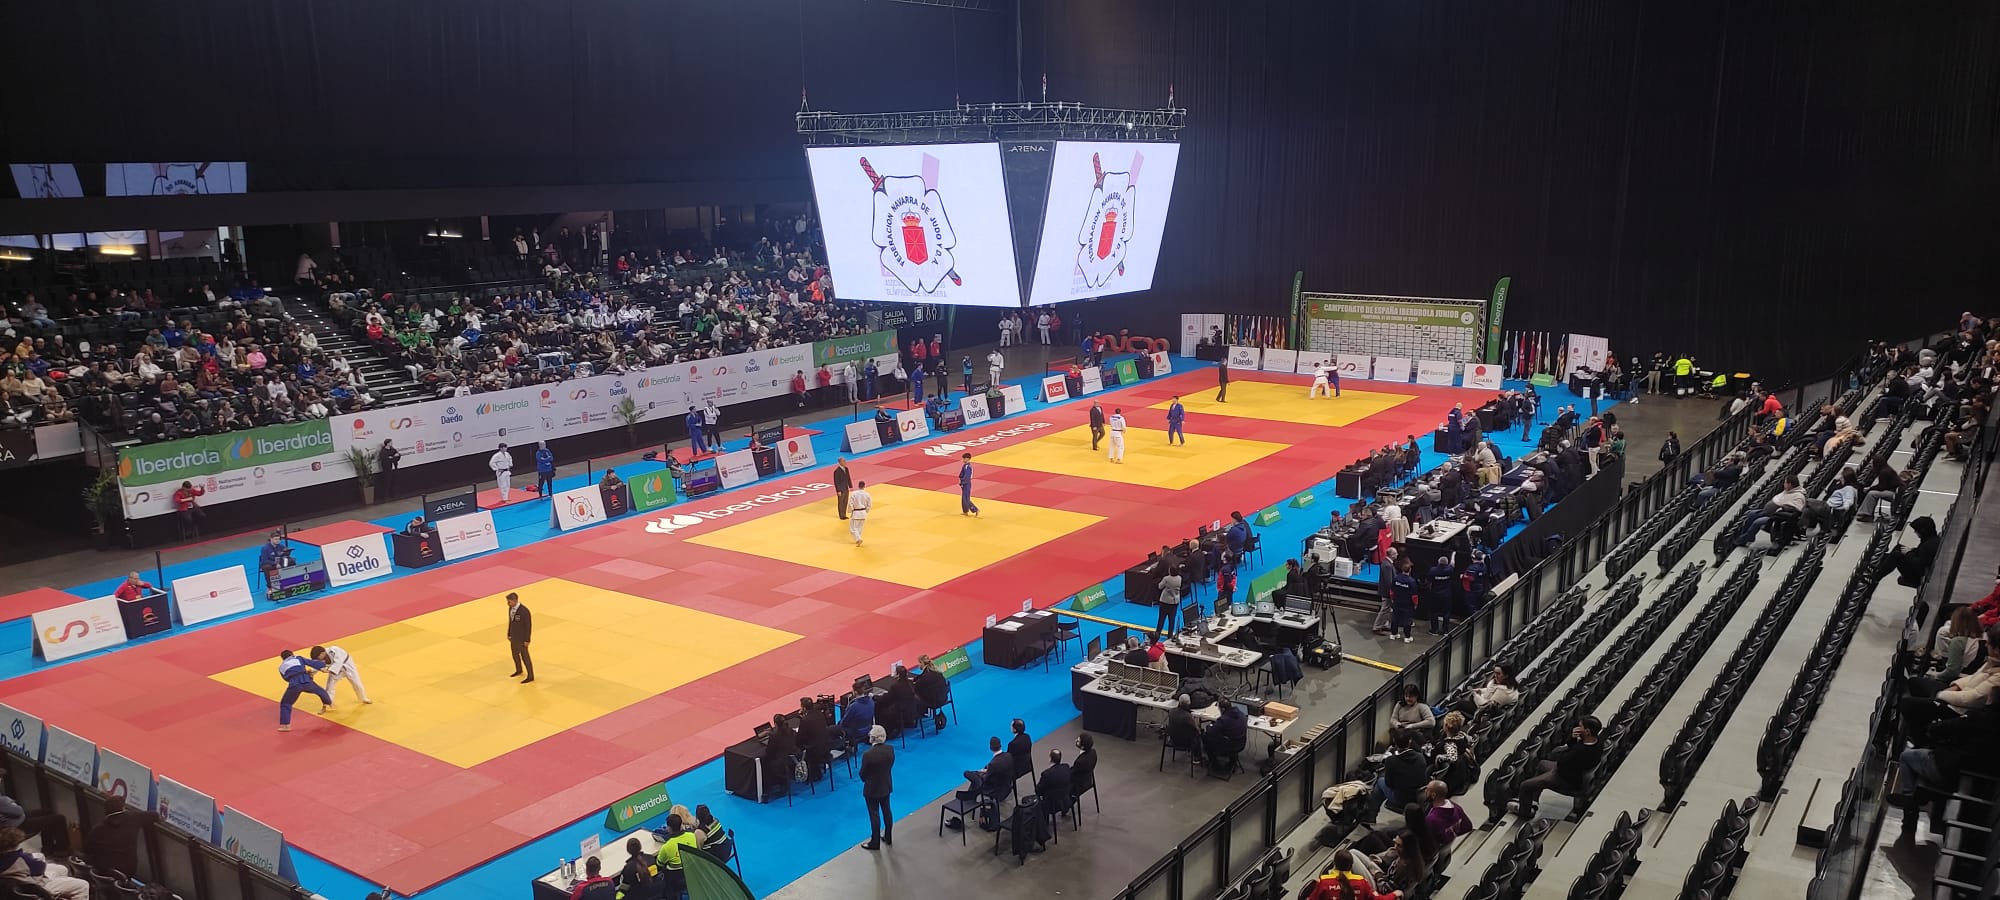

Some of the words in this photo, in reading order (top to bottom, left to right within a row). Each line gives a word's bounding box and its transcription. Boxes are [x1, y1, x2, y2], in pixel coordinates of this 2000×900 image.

[891, 196, 918, 212] NAVARRA
[920, 202, 930, 215] DE
[930, 216, 942, 240] JUDO
[1089, 209, 1101, 263] FEDERACION
[1101, 191, 1121, 209] NAVARRA
[886, 213, 905, 267] FEDERACION
[884, 310, 904, 318] SALIDA
[1323, 303, 1364, 314] CAMPEONATO
[1365, 306, 1374, 314] DE
[1374, 306, 1398, 316] ESPAÑA
[1435, 310, 1459, 319] JUNIOR
[1493, 288, 1505, 325] Iberdrola
[836, 341, 871, 357] Iberdrola
[1232, 356, 1253, 366] Daedo
[651, 375, 681, 386] Iberdrola
[610, 387, 627, 396] Daedo
[492, 400, 529, 412] Iberdrola
[967, 407, 986, 419] Daedo
[441, 414, 463, 425] Daedo
[257, 430, 332, 455] Iberdrola
[952, 422, 1054, 447] Iberdrola
[136, 450, 220, 476] Iberdrola
[434, 500, 466, 513] ARENA
[699, 482, 833, 520] Iberdrola
[337, 554, 380, 577] Daedo
[291, 584, 311, 596] 2:22
[946, 655, 968, 668] Iberdrola
[633, 793, 668, 814] Iberdrola
